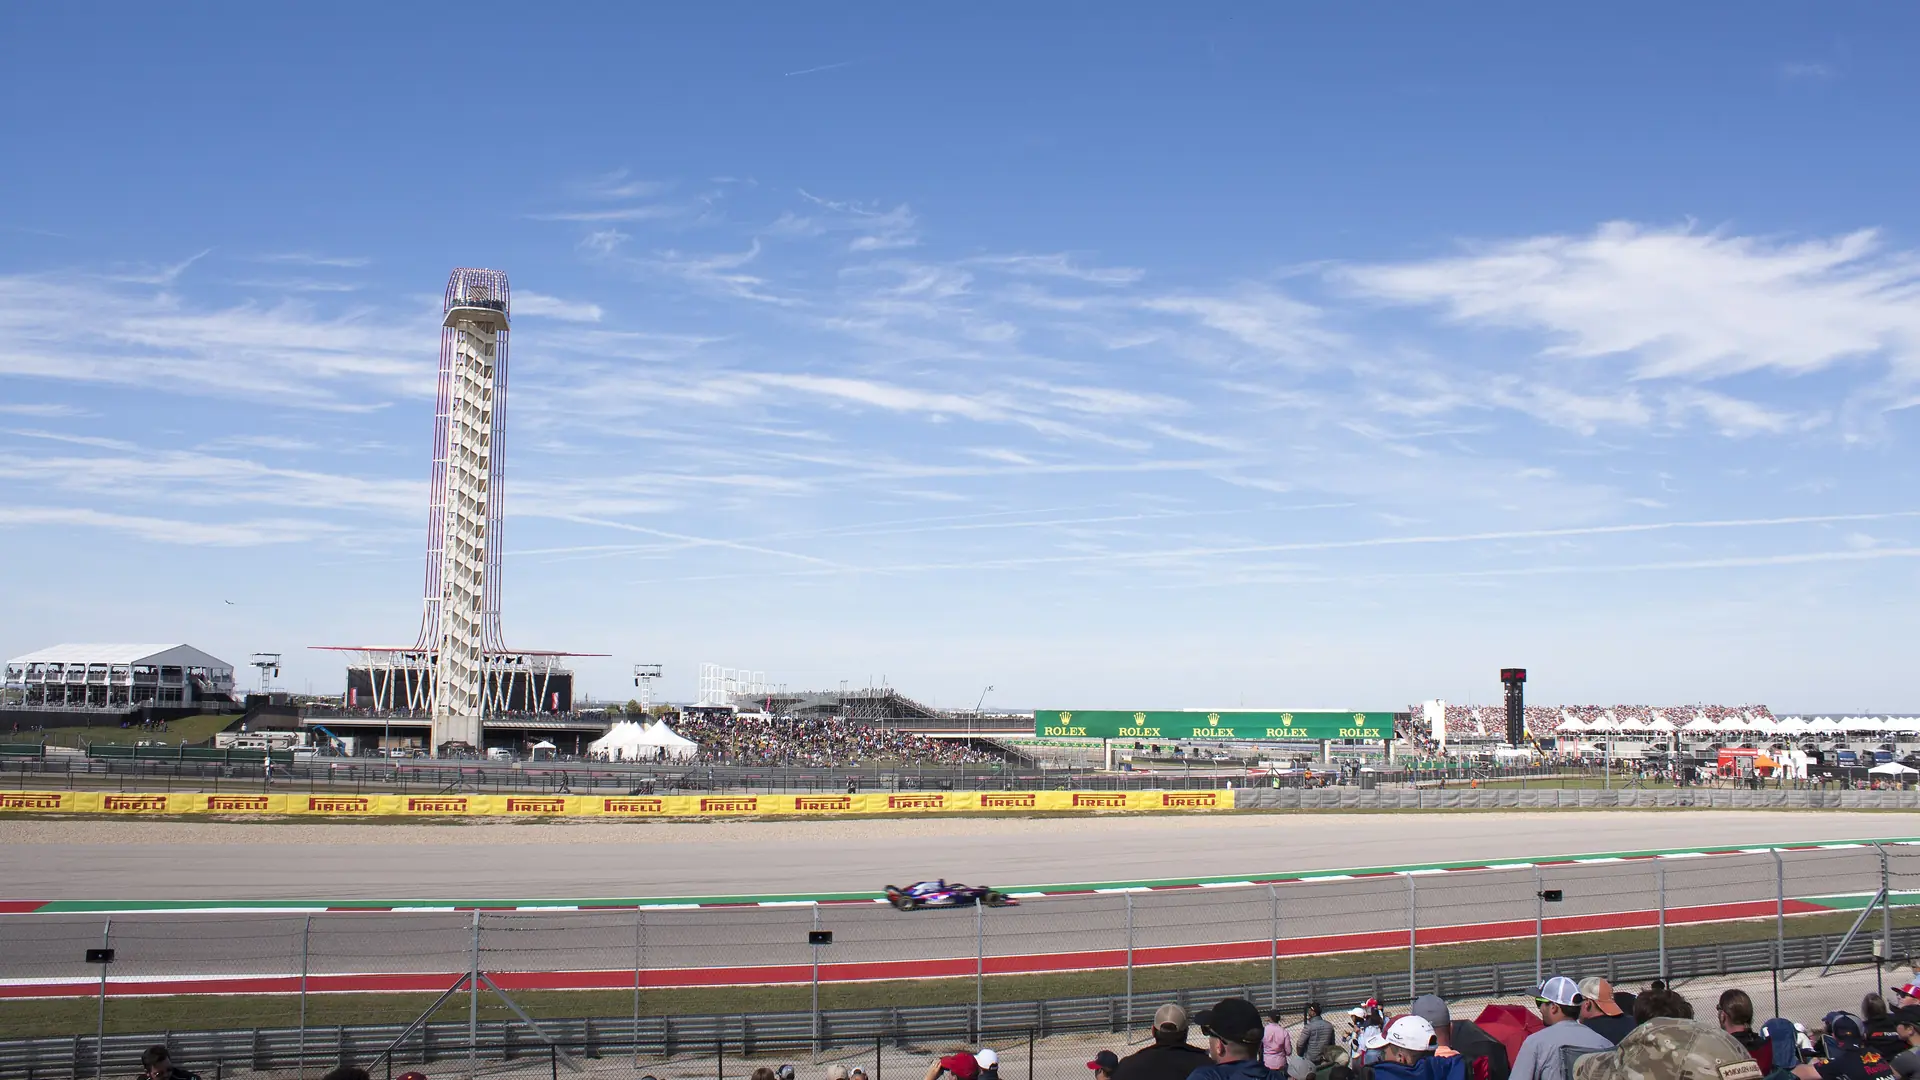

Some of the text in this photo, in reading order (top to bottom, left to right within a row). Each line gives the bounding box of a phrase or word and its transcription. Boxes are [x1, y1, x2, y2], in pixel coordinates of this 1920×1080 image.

[1044, 727, 1086, 736] ROLEX
[1119, 728, 1160, 736] ROLEX
[1193, 728, 1234, 737] ROLEX
[1267, 728, 1307, 737] ROLEX
[1340, 729, 1380, 737] ROLEX
[0, 793, 62, 809] PIRELLI
[104, 795, 167, 810] PIRELLI
[207, 796, 269, 810] PIRELLI
[308, 797, 369, 812] PIRELLI
[408, 798, 468, 812] PIRELLI
[506, 798, 565, 813] PIRELLI
[604, 799, 662, 812] PIRELLI
[700, 797, 758, 812] PIRELLI
[795, 796, 852, 810] PIRELLI
[888, 795, 944, 809] PIRELLI
[980, 793, 1036, 807] PIRELLI
[1072, 793, 1127, 807] PIRELLI
[1162, 793, 1216, 806] PIRELLI
